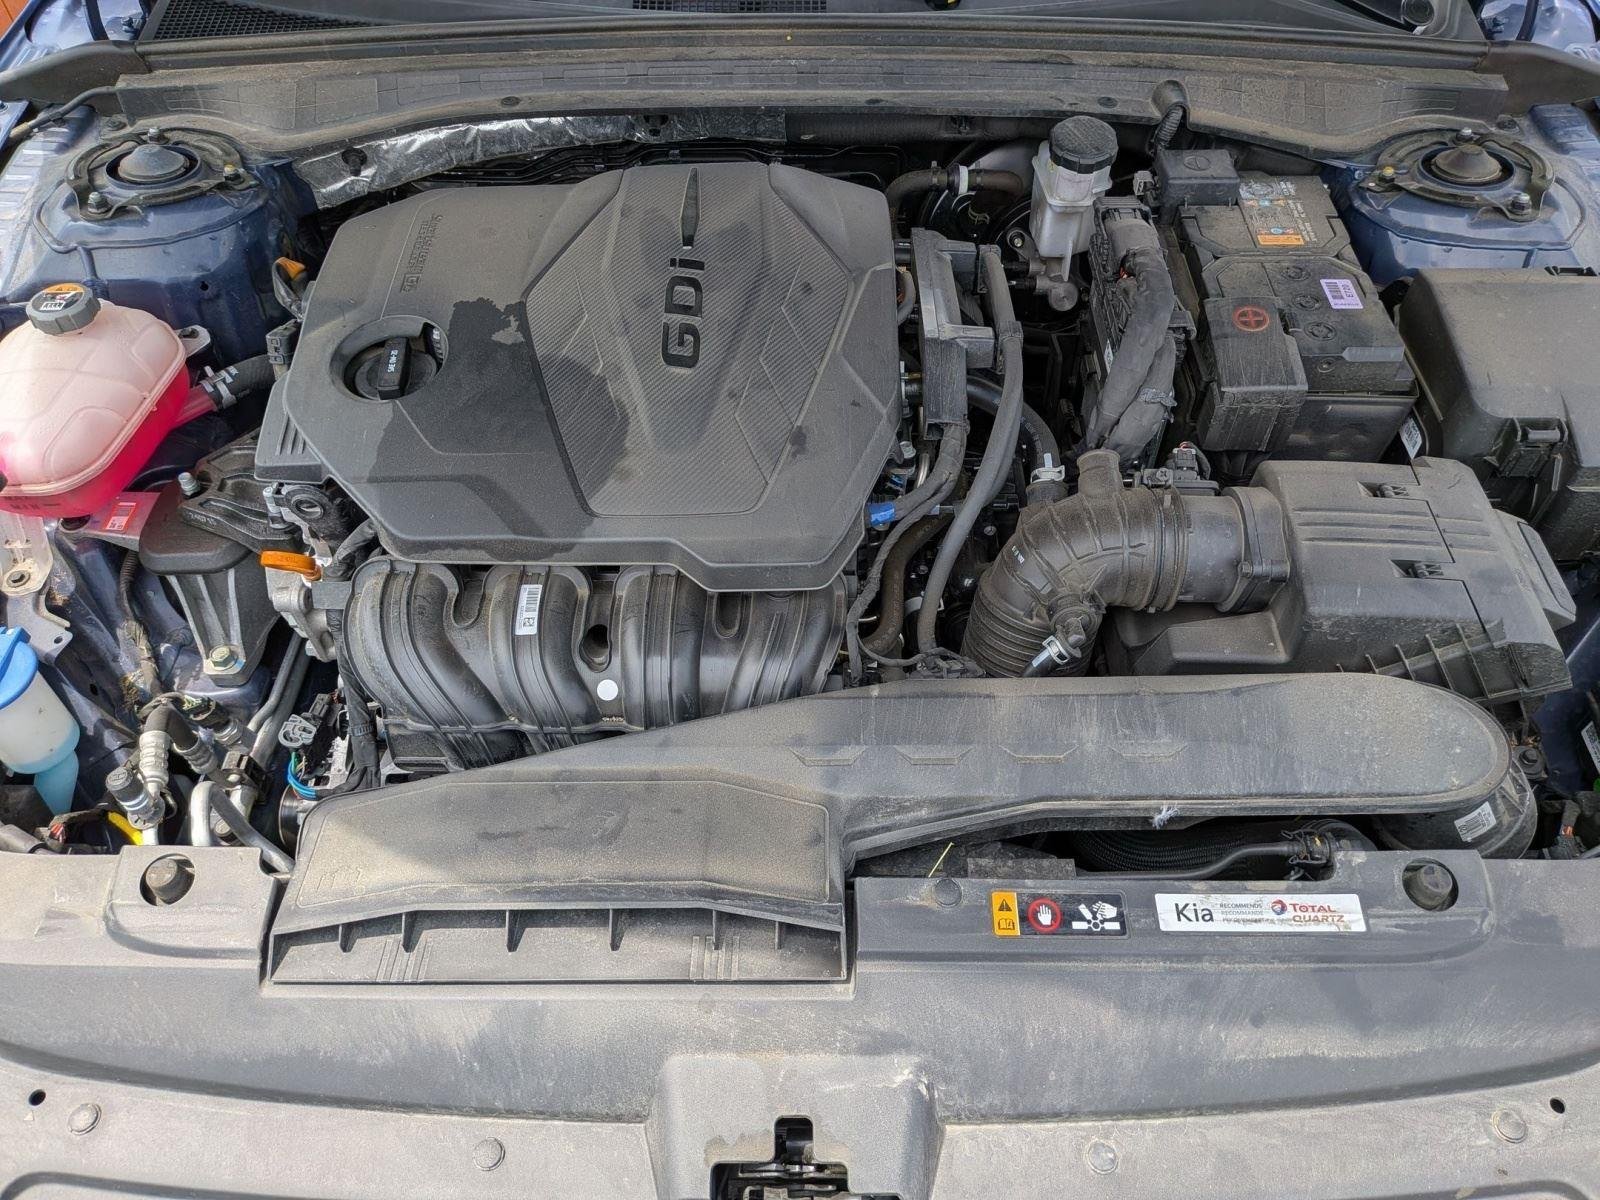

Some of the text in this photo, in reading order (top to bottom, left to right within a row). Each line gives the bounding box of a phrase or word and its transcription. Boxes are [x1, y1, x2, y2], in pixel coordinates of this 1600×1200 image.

[661, 257, 705, 369] GDi
[1174, 903, 1214, 923] Kia
[1292, 914, 1345, 923] QUARTZ
